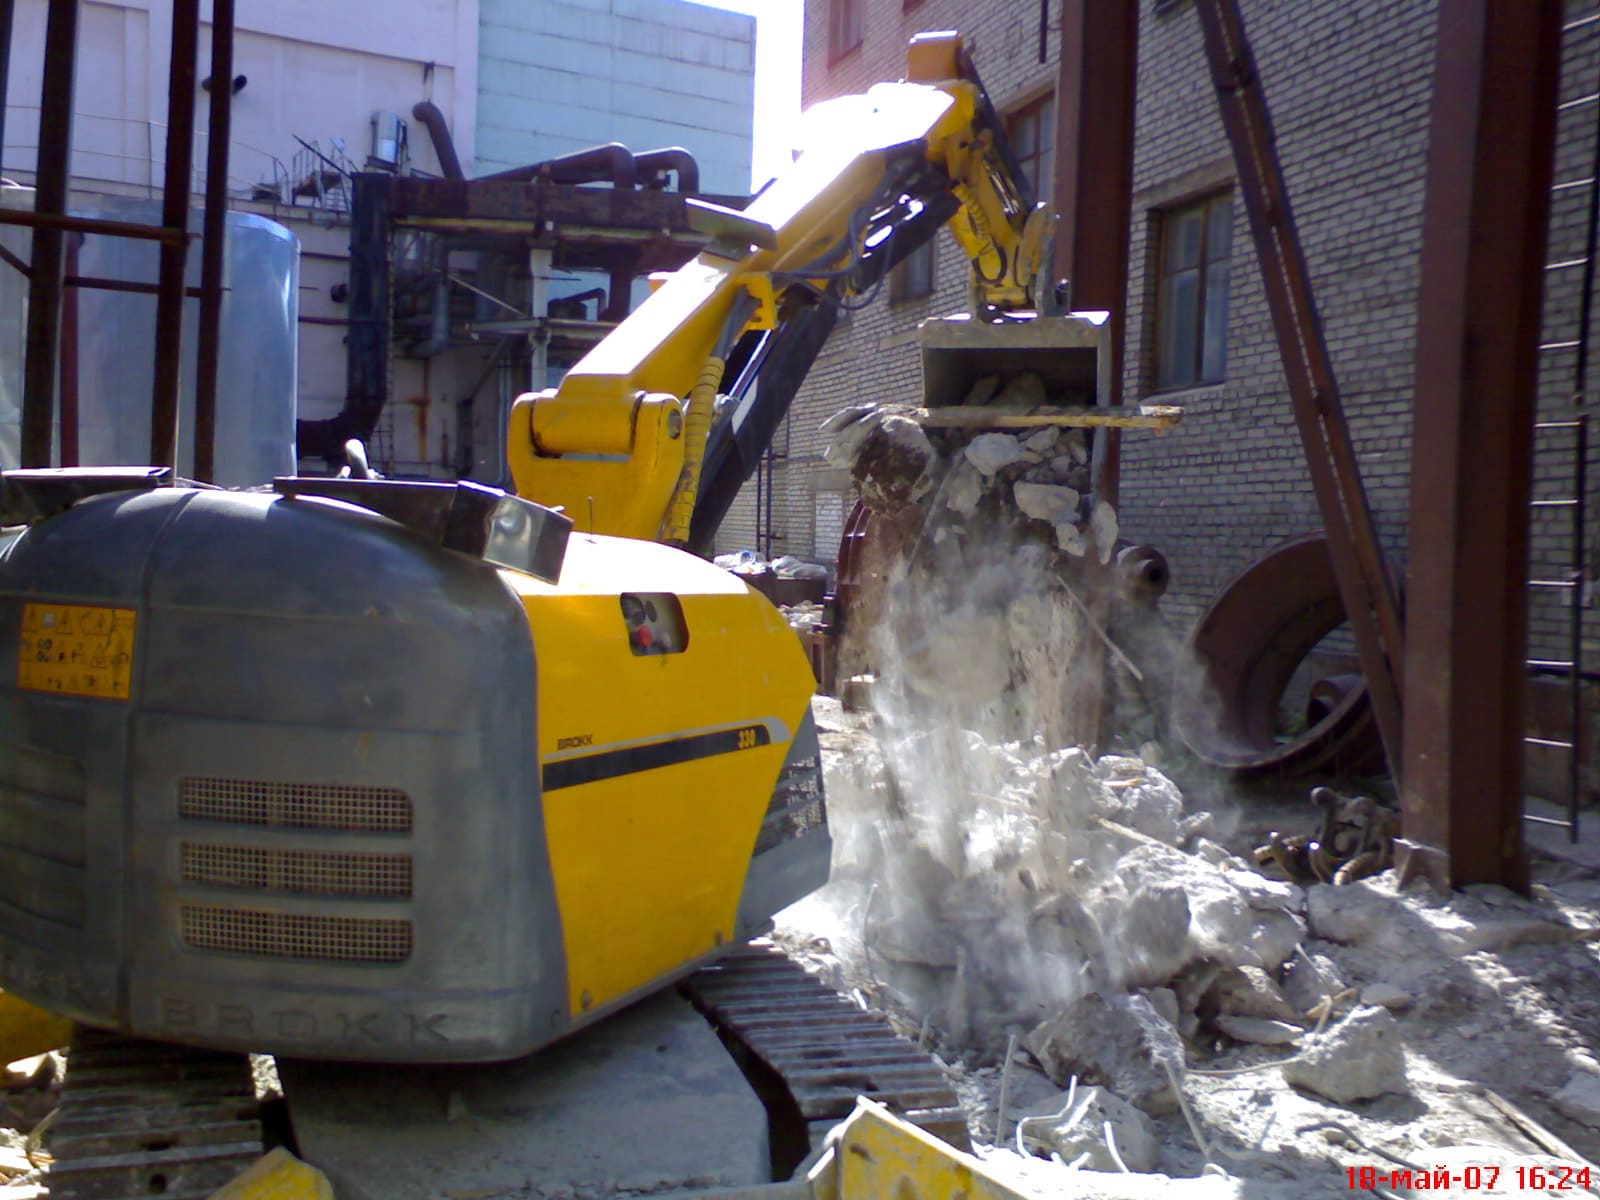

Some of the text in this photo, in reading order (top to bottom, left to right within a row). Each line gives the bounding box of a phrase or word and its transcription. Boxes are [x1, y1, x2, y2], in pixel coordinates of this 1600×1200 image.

[557, 734, 593, 751] BROKK
[738, 728, 756, 749] 330
[162, 997, 448, 1043] BROKK
